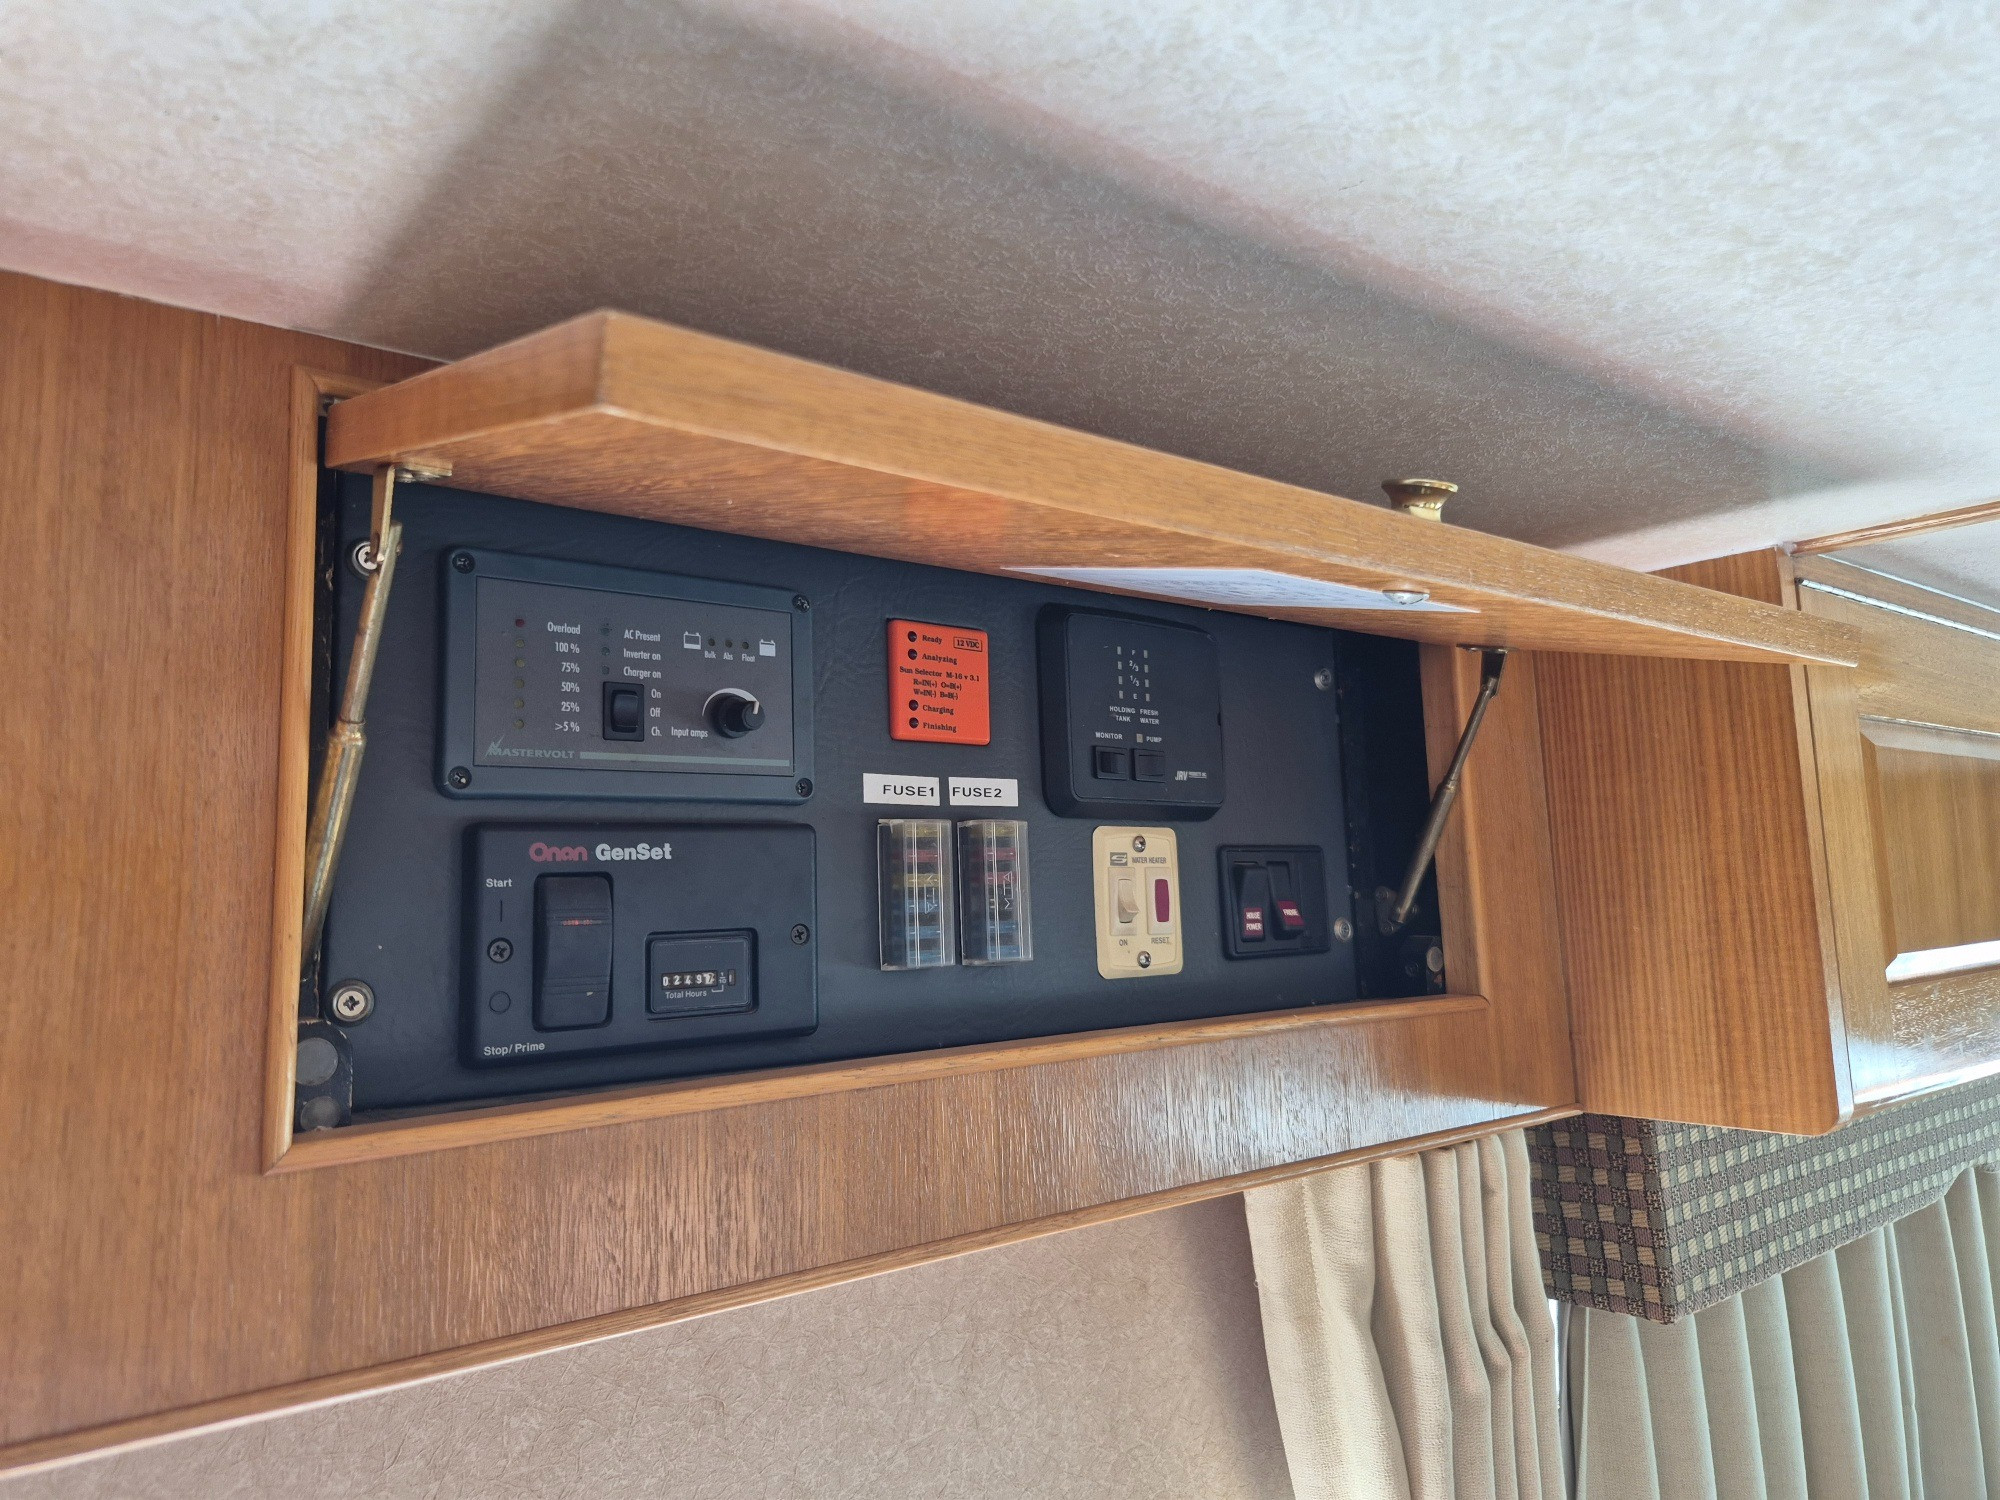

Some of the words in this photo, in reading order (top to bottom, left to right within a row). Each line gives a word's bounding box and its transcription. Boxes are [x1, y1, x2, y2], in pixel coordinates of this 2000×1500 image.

[547, 621, 581, 635] Overload
[624, 629, 634, 640] AC
[635, 631, 661, 642] Present
[922, 634, 943, 645] Ready
[555, 641, 569, 653] 100
[570, 642, 580, 654] %
[956, 639, 965, 647] 12
[966, 640, 980, 649] VDC
[623, 648, 650, 660] Inverter
[652, 652, 661, 661] on
[704, 650, 716, 660] Bulk
[723, 652, 733, 661] Abs
[741, 653, 756, 663] Float
[922, 653, 958, 666] Analyzing
[561, 661, 580, 674] 75%
[1128, 660, 1139, 672] 2/3
[623, 666, 651, 680] Charger
[652, 670, 661, 679] on
[899, 666, 913, 674] Sun
[914, 668, 943, 678] Selector
[946, 671, 963, 680] M-16
[969, 674, 980, 682] 3.1
[1129, 675, 1140, 687] 1/3
[561, 681, 580, 693] 50%
[651, 688, 661, 699] On
[561, 701, 580, 713] 25%
[650, 707, 661, 718] Off
[922, 704, 955, 716] Charging
[1109, 705, 1136, 714] HOLDING
[1140, 708, 1159, 716] FRESH
[1115, 715, 1131, 723] TANK
[1140, 717, 1160, 725] WATER
[651, 726, 663, 737] Ch.
[671, 726, 689, 739] Input
[690, 729, 709, 740] amps
[923, 722, 957, 734] Finishing
[1095, 731, 1123, 740] MONITOR
[1146, 735, 1162, 743] PUMP
[484, 738, 575, 760] MASTERVOLT
[882, 784, 935, 798] FUSE1
[952, 786, 1003, 798] FUSE2
[529, 842, 588, 862] Onan
[595, 842, 672, 861] GenSet
[1131, 856, 1148, 864] WATER
[1148, 856, 1167, 864] HEATER
[485, 878, 513, 888] Start
[1245, 922, 1262, 931] POWER
[1151, 936, 1170, 945] RESET
[665, 990, 684, 999] Total
[685, 989, 708, 999] Hours
